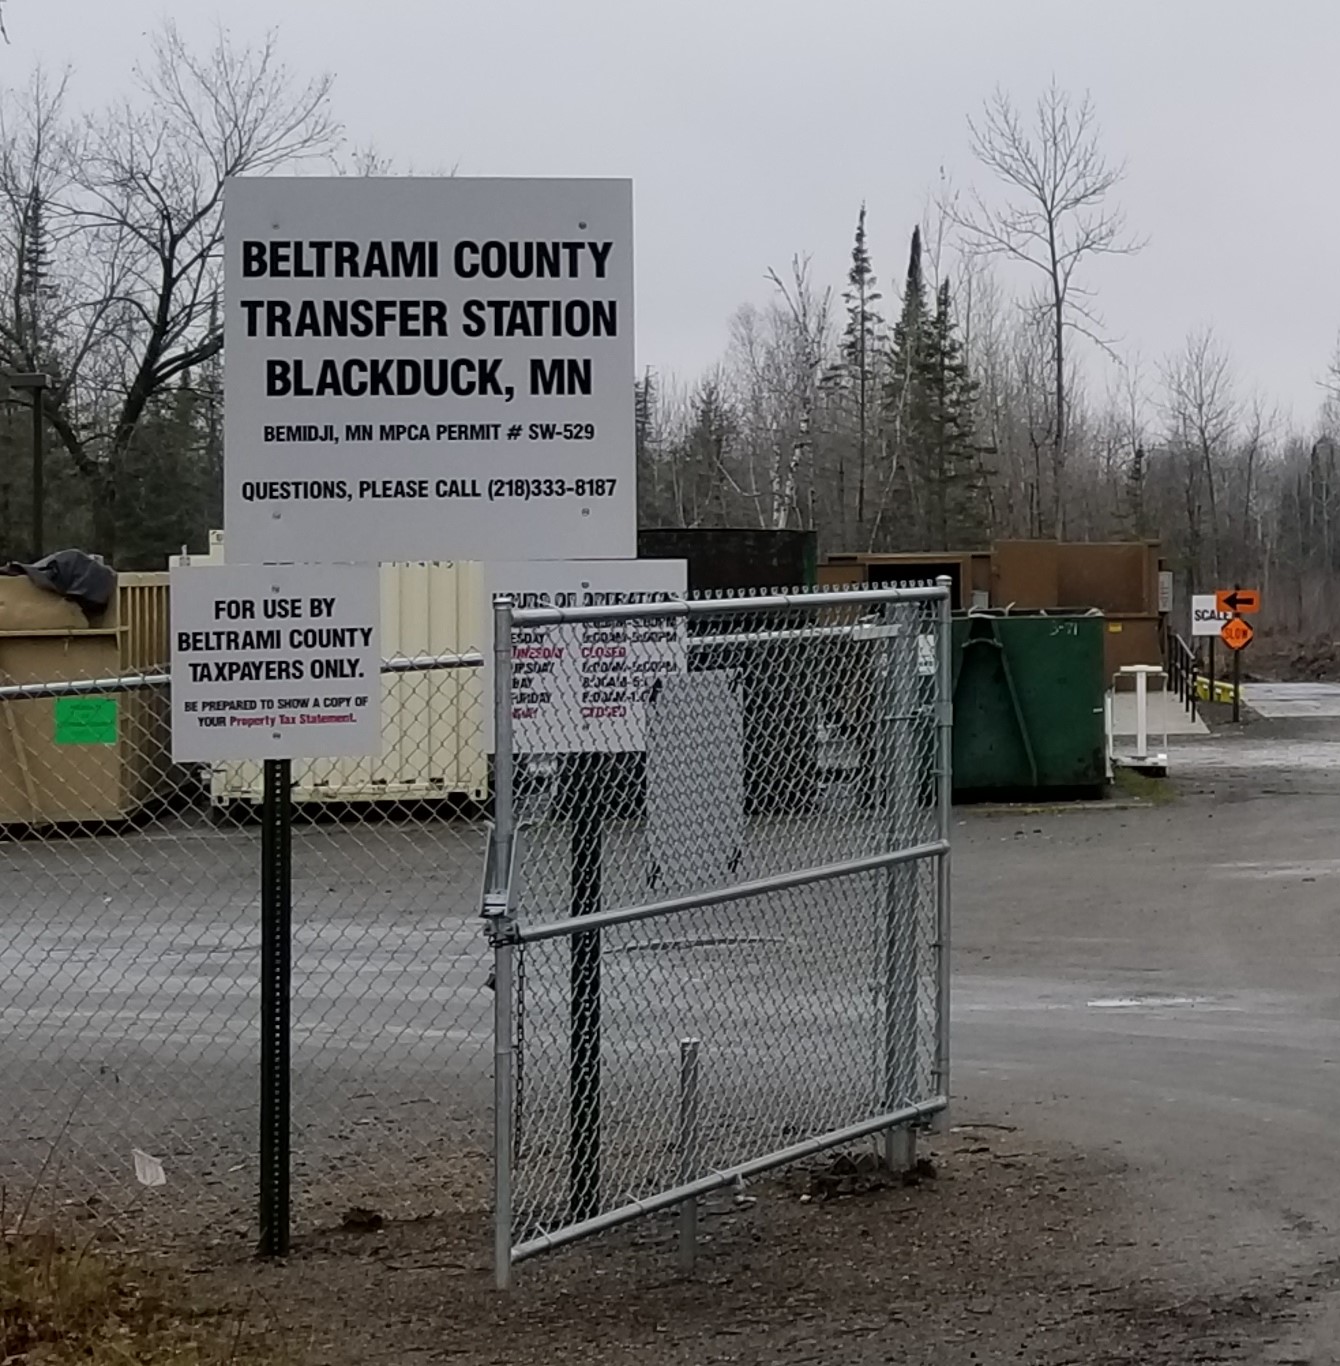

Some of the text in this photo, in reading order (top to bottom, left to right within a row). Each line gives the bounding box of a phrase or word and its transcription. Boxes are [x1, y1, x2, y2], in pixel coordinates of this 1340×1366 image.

[243, 240, 613, 278] BELTRAMI COUNTY
[240, 299, 617, 337] TRANSFER STATION
[266, 358, 592, 402] BLACKDUCK, MN
[264, 423, 595, 444] BEMIDJI, MN MPCA PERMIT # SW-529
[242, 478, 617, 502] QUESTIONS, PLEASE CALL (218)333-8187
[214, 597, 336, 620] FOR USE BY
[1195, 609, 1230, 621] SCALE
[178, 627, 373, 652] BELTRAMI COUNTY
[1224, 627, 1248, 640] SLOW
[581, 646, 626, 659] CLOSED
[188, 658, 364, 682] TAXPAYERS ONLY.
[184, 696, 368, 712] BE PREPARED TO SHOW A COPY OF
[197, 716, 226, 727] YOUR
[230, 714, 275, 728] Property
[279, 714, 296, 725] Tax
